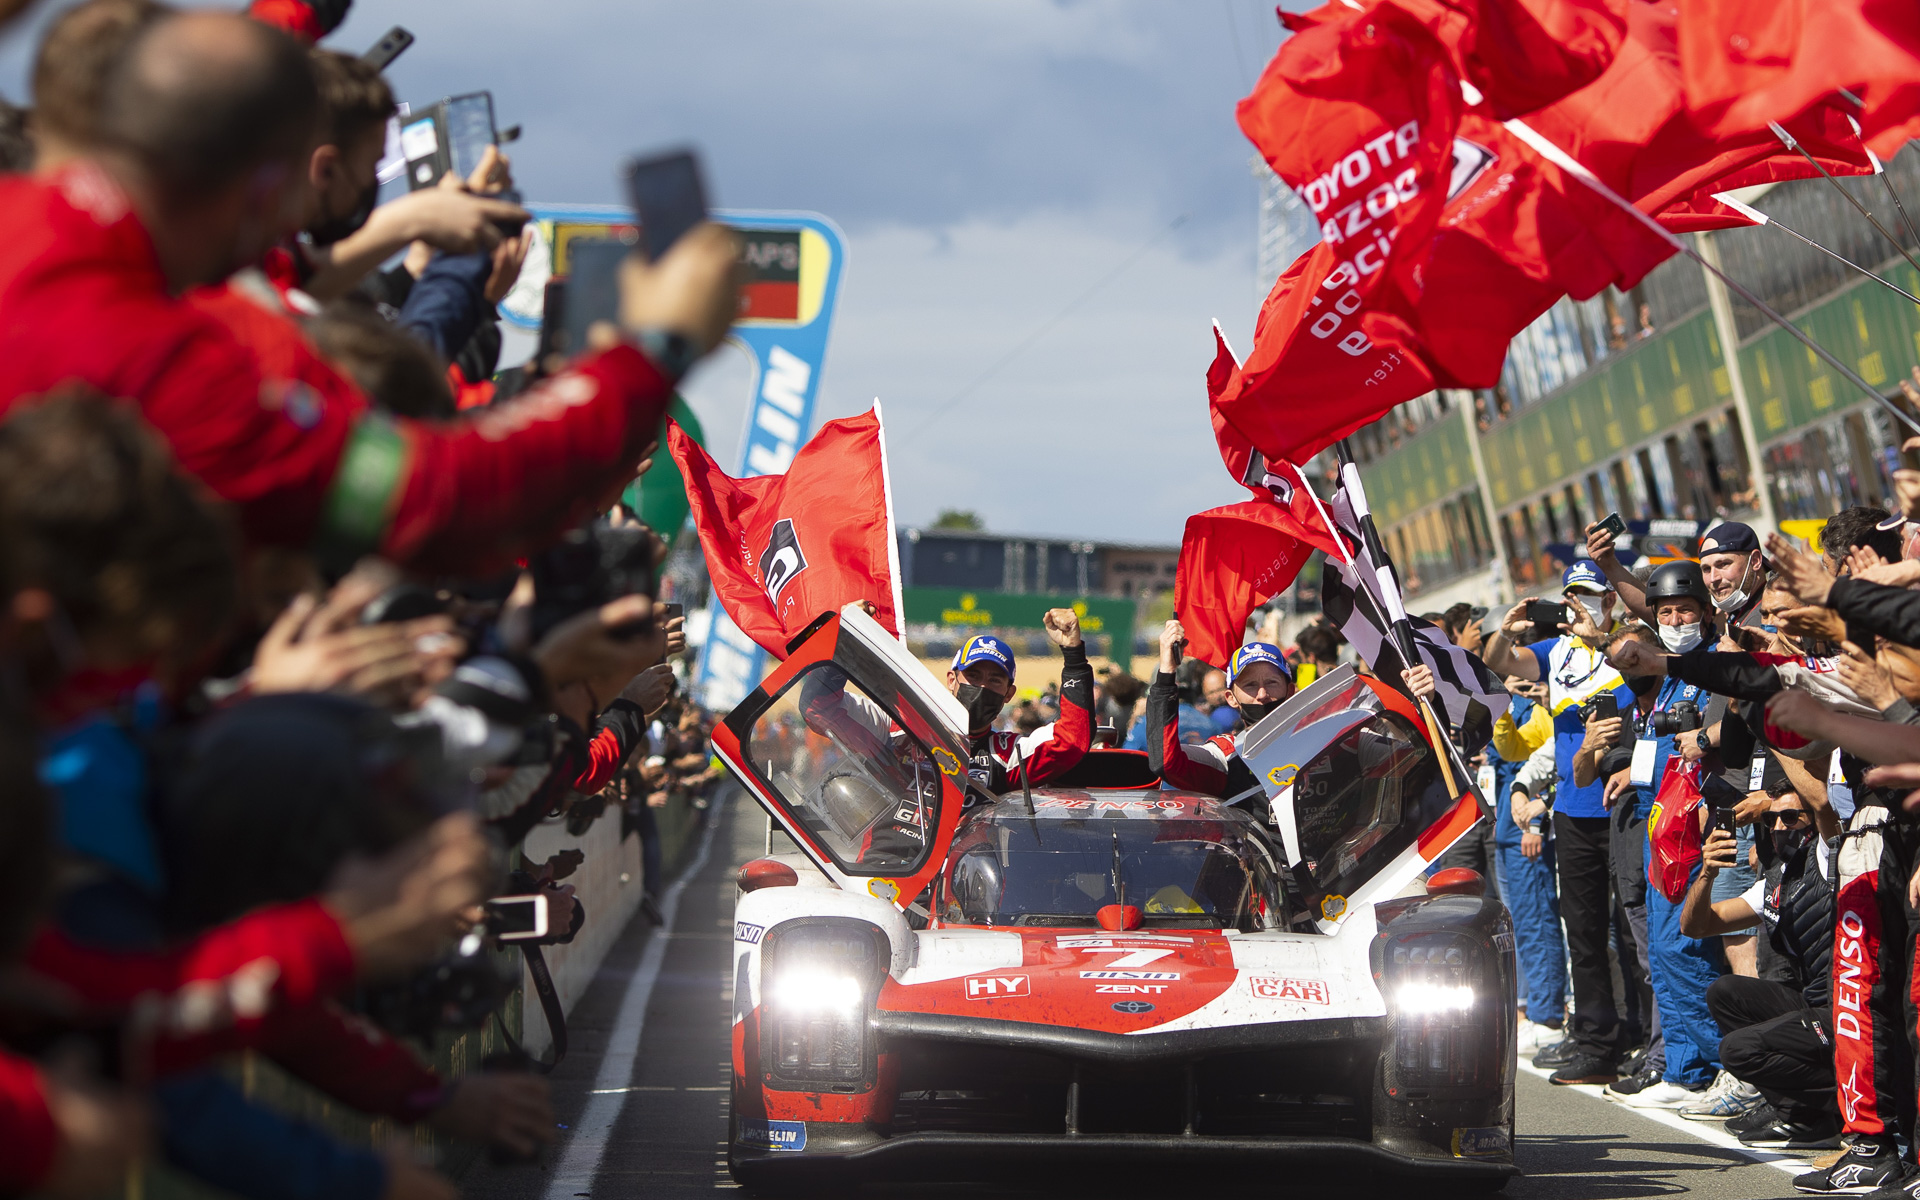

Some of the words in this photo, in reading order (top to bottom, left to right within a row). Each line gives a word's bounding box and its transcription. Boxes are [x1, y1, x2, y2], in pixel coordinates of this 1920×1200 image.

[1297, 119, 1420, 213] OYOTA
[745, 241, 798, 270] APS
[968, 648, 1008, 663] MICHELIN
[1035, 799, 1185, 811] DENSO
[893, 825, 923, 840] RACIN
[1081, 948, 1175, 968] 7
[1255, 978, 1321, 989] HYPER
[1837, 910, 1863, 1041] DENSO
[969, 977, 1025, 995] HY
[1095, 984, 1168, 994] ZENT
[1257, 984, 1323, 1002] CAR
[746, 1128, 796, 1142] MICHELIN
